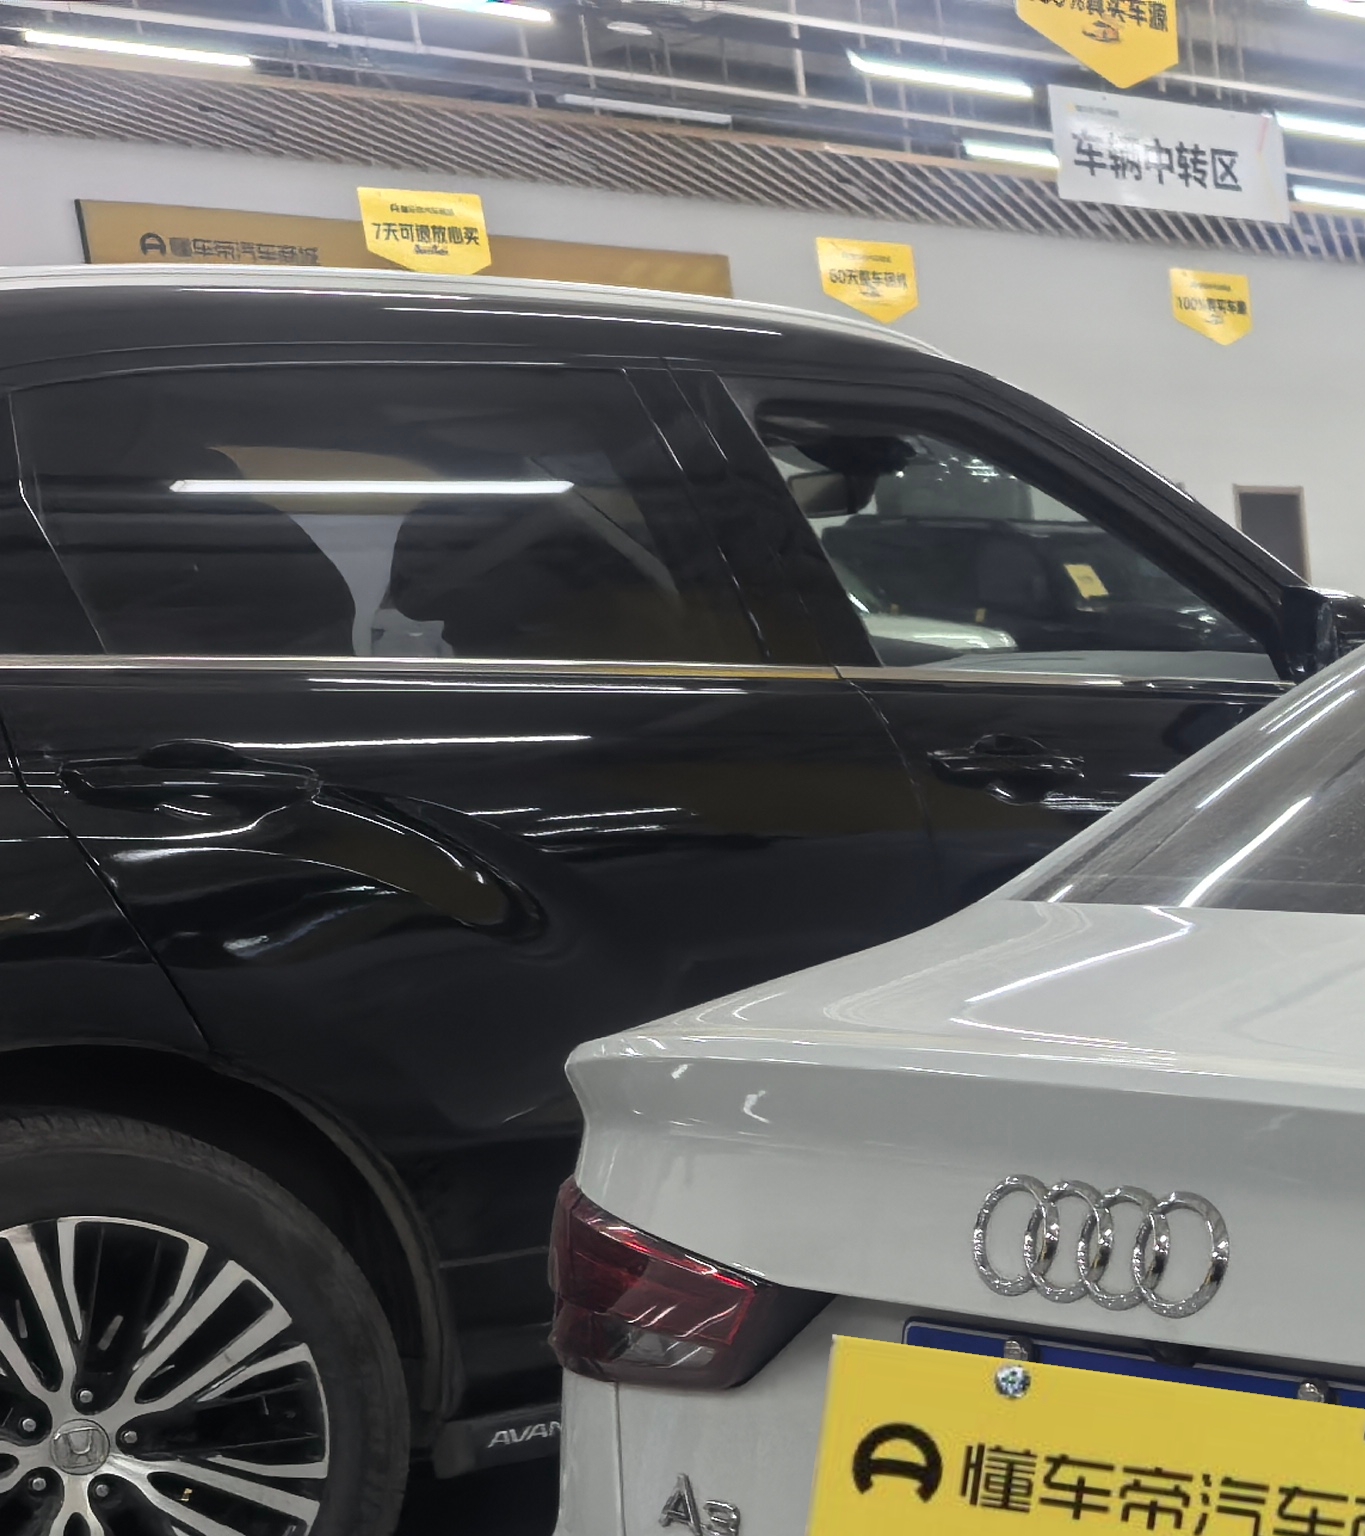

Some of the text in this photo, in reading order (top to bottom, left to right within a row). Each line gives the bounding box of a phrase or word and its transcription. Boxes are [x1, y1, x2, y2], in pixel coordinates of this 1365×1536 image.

[1071, 129, 1243, 192] 车辆中转区
